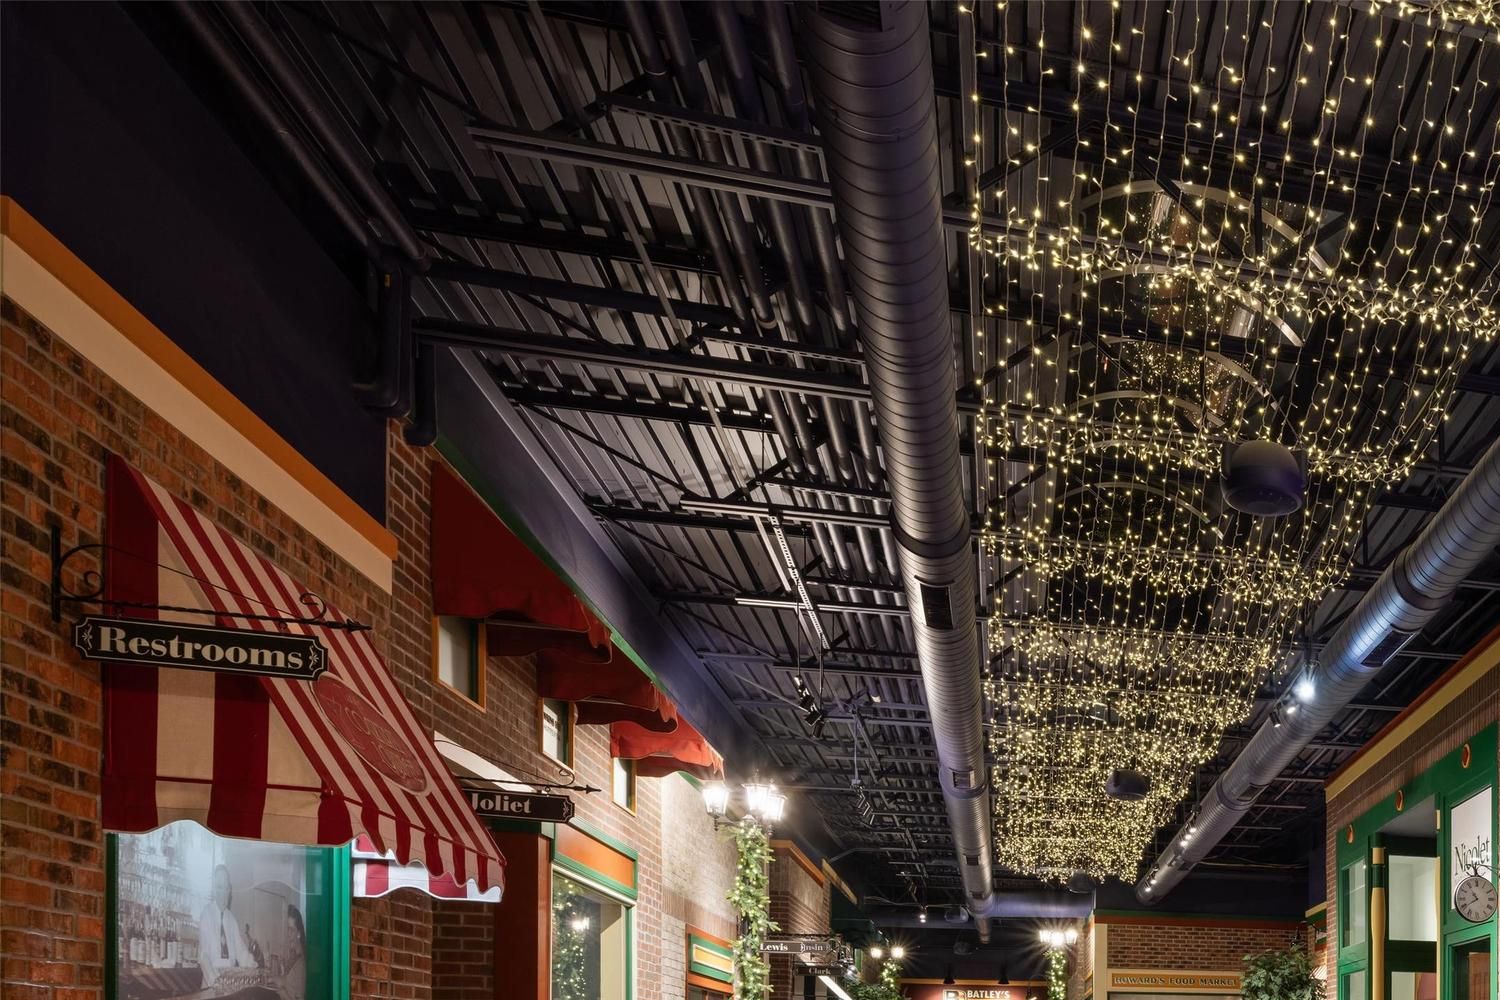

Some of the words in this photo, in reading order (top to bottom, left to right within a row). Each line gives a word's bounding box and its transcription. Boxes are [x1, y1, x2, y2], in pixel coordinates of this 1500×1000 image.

[98, 625, 304, 670] Restrooms
[471, 792, 532, 814] Joliet
[1455, 835, 1490, 876] Nicolet
[760, 942, 788, 951] Lewis
[808, 967, 831, 975] Clark
[1114, 976, 1165, 984] HOWARD'S
[1169, 977, 1196, 985] FOOD
[1200, 978, 1237, 987] MARKET
[967, 990, 1010, 999] BATLEY'S
